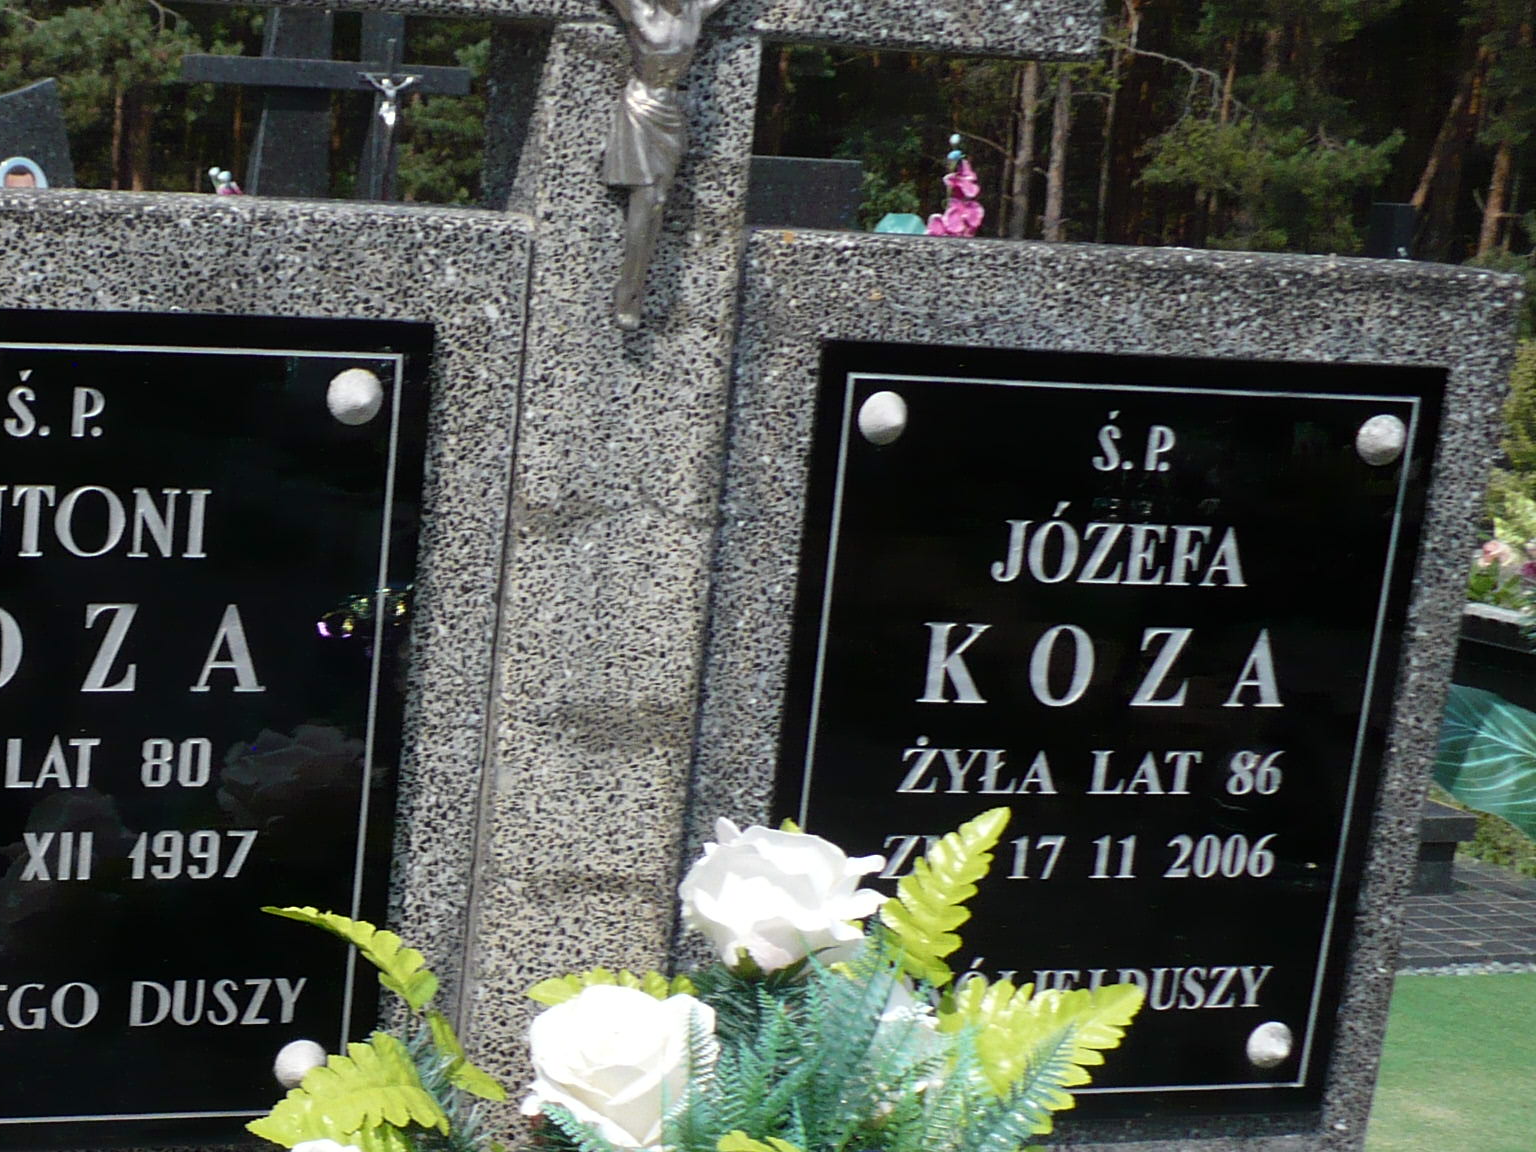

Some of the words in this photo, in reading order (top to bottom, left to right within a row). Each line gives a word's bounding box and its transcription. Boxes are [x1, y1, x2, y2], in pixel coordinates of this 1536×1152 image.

[991, 501, 1248, 588] JÓZEFA
[4, 735, 102, 790] LAT
[141, 737, 213, 788] 80
[896, 736, 1059, 796] ŻYŁA
[1086, 750, 1202, 796] LAT
[1226, 750, 1284, 796] 86
[20, 831, 93, 882] XII
[127, 830, 258, 881] 1997
[1005, 835, 1066, 880] 17
[1088, 834, 1137, 880] 11
[1163, 832, 1278, 880] 2006
[129, 976, 308, 1028] DUSZY
